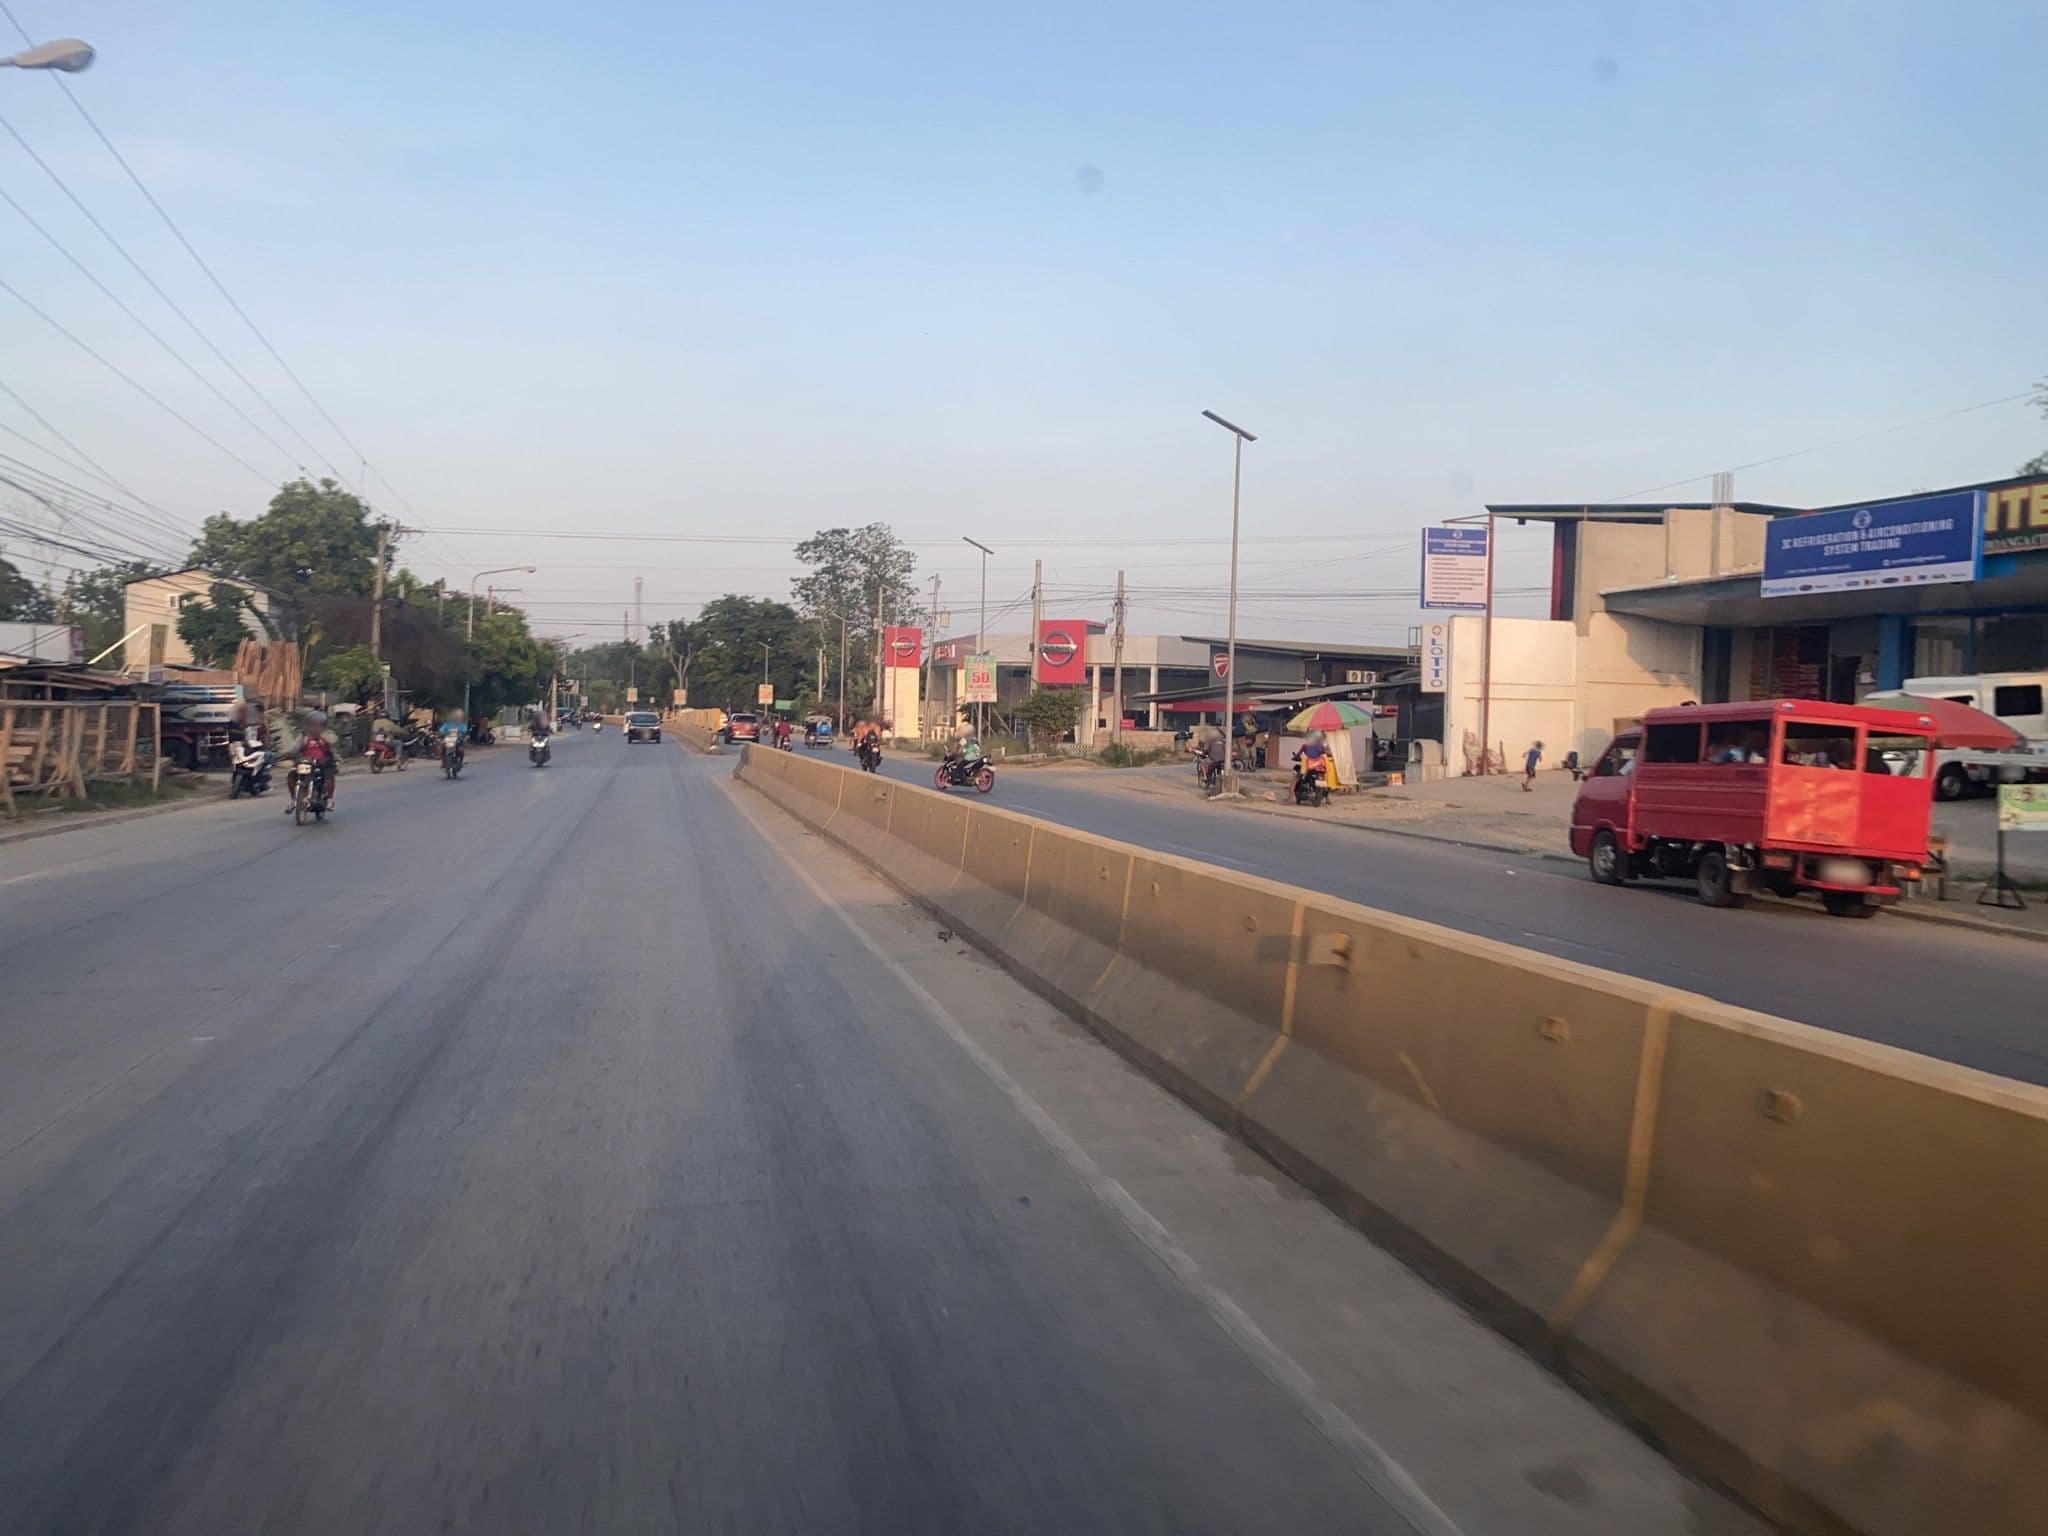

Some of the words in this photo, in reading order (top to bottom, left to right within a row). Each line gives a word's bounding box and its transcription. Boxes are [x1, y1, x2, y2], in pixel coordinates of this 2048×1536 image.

[1793, 531, 1858, 548] REFRIGERATION
[1824, 542, 1859, 556] SYSTEM
[1860, 537, 1902, 552] TRADING
[972, 671, 990, 683] 50
